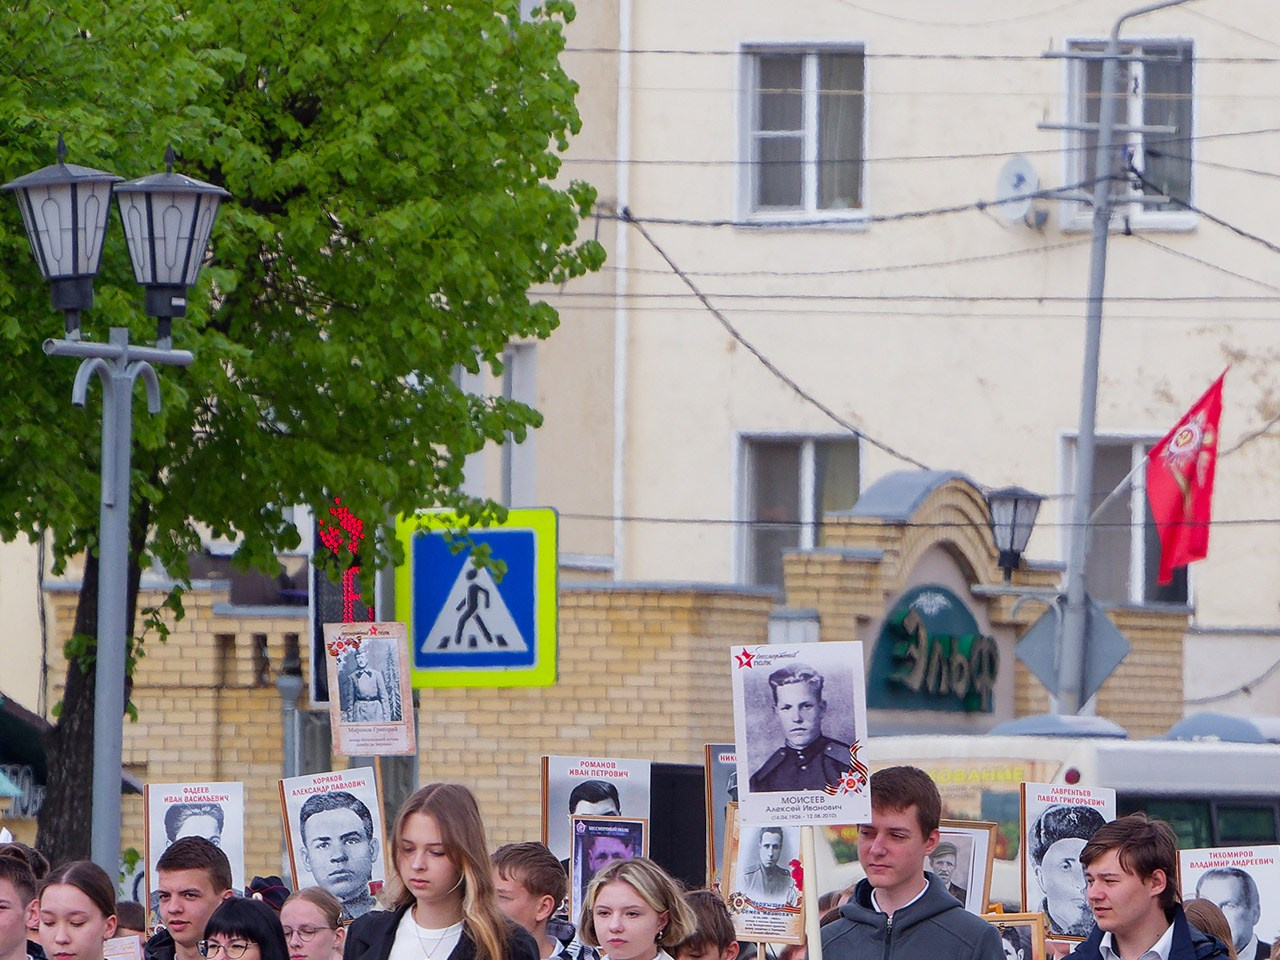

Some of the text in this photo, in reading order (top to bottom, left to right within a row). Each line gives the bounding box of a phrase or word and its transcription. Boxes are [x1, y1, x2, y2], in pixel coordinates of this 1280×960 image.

[580, 760, 616, 769] РОМАНОВ
[590, 769, 629, 778] ПЕТРОВИЧ
[312, 774, 343, 785] КОРЯКОВ
[292, 780, 366, 796] АЛЕКСАНДР ПАВЛОВИЧ
[1050, 787, 1092, 797] ЛАВРЕНТЬЕВ
[184, 795, 229, 803] ВАСИЛЬЕВИЧ
[781, 796, 825, 804] МОИСЕЕВ
[1037, 795, 1105, 806] ПАВЕЛ ГРИГОРЬЕВИЧ
[1209, 850, 1254, 859] ТИХОМИРОВ
[1190, 858, 1274, 869] ВЛАДИМИР АНДРЕЕВИЧ
